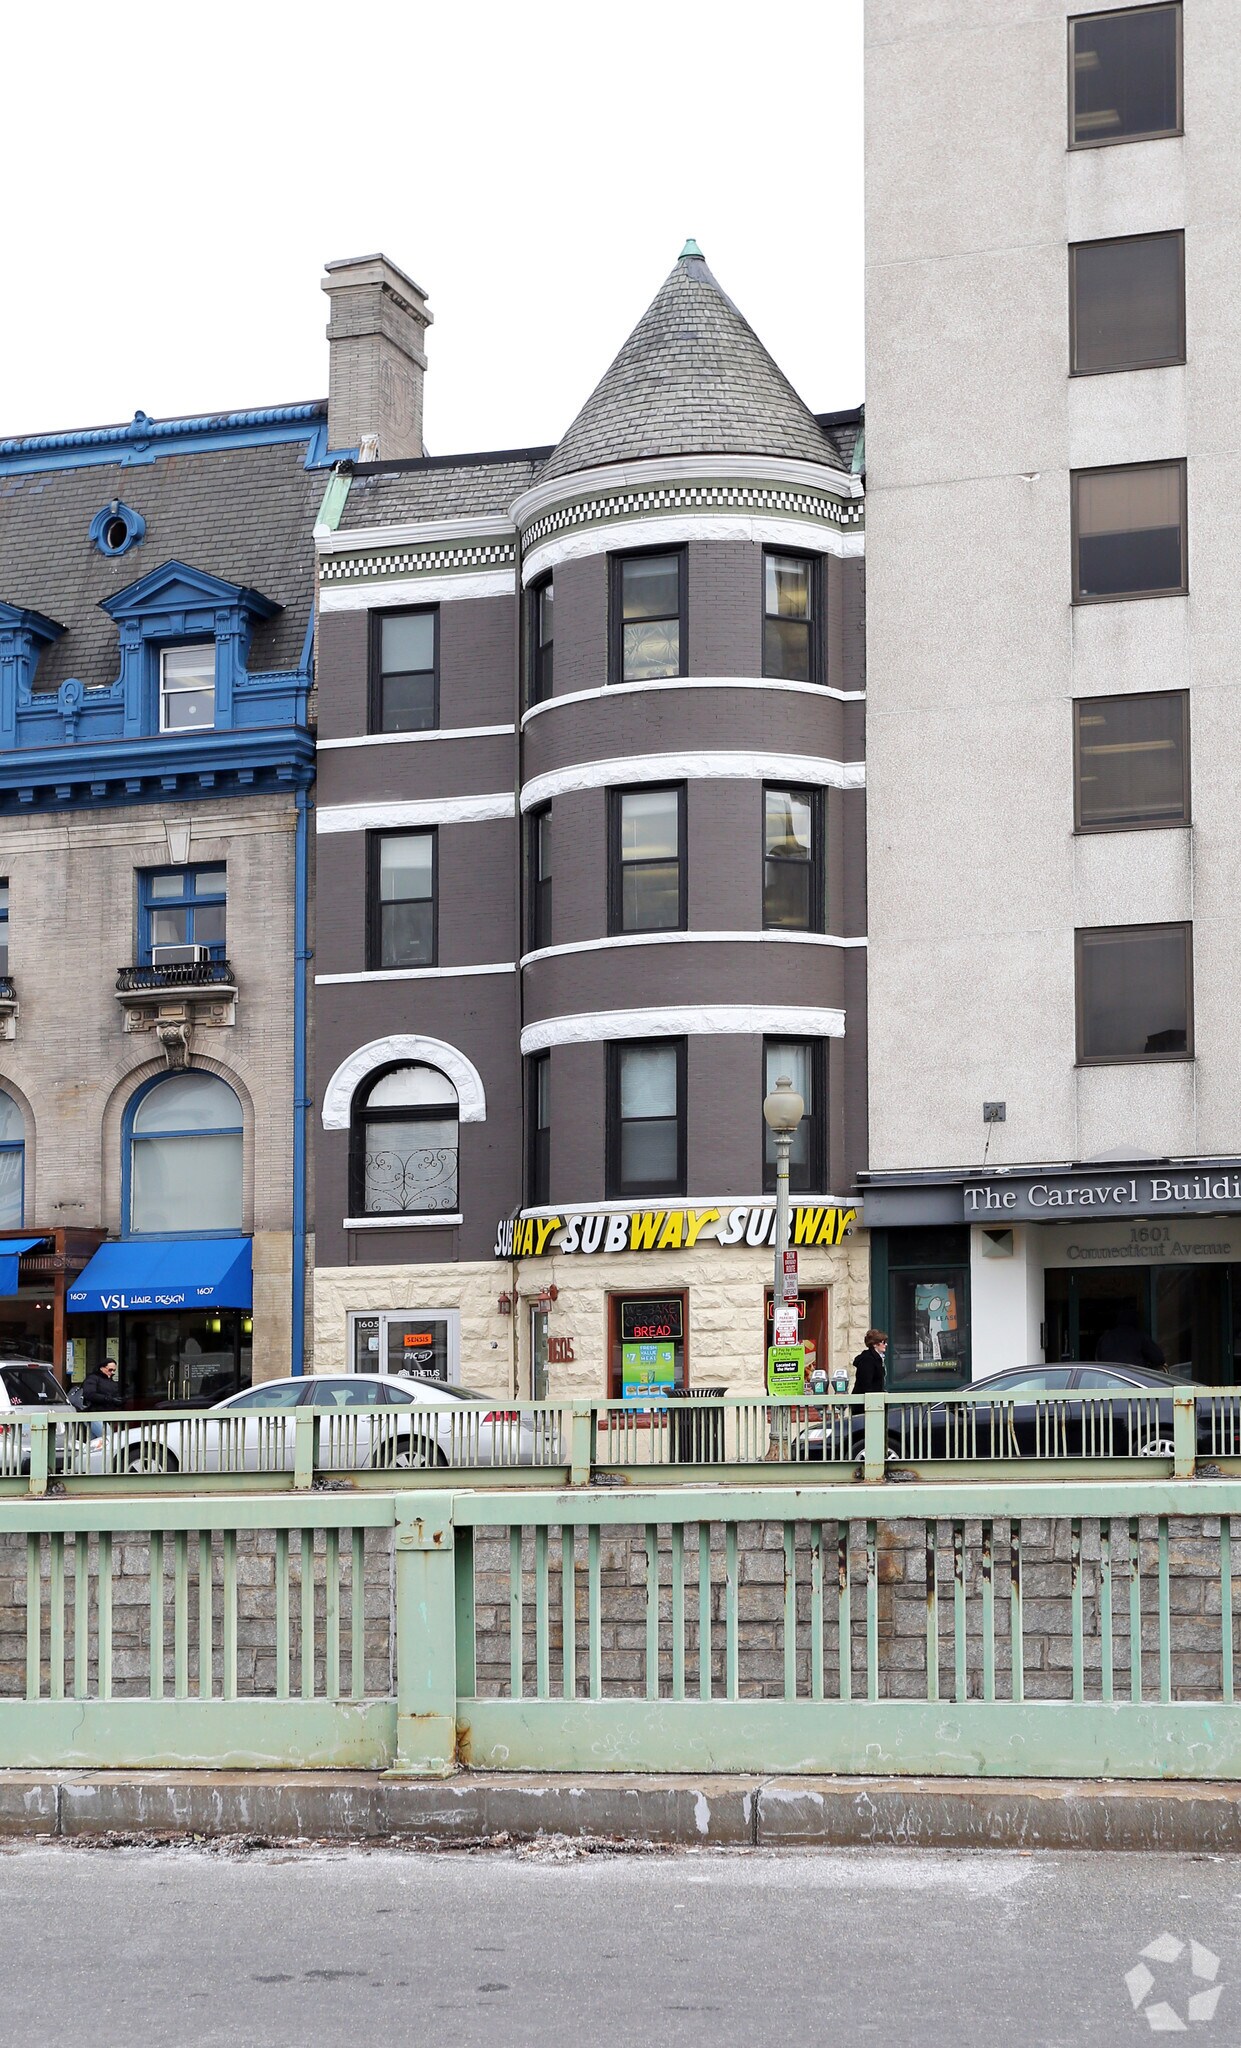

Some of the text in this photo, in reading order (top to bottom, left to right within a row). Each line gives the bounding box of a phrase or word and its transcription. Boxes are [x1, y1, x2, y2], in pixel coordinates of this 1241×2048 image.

[964, 1187, 1016, 1210] The
[1028, 1180, 1138, 1207] Caravel
[494, 1216, 562, 1257] SUBWAY
[560, 1208, 721, 1254] SUBWAY
[1130, 1227, 1171, 1242] 1601
[1066, 1241, 1231, 1260] Connecticut Avenue
[196, 1287, 214, 1295] 1607
[100, 1294, 129, 1309] VSL
[131, 1295, 152, 1304] HAIR
[155, 1293, 185, 1305] DESIGN
[633, 1325, 671, 1337] BREAD
[547, 1337, 574, 1363] 1605
[412, 1369, 440, 1377] THETUS
